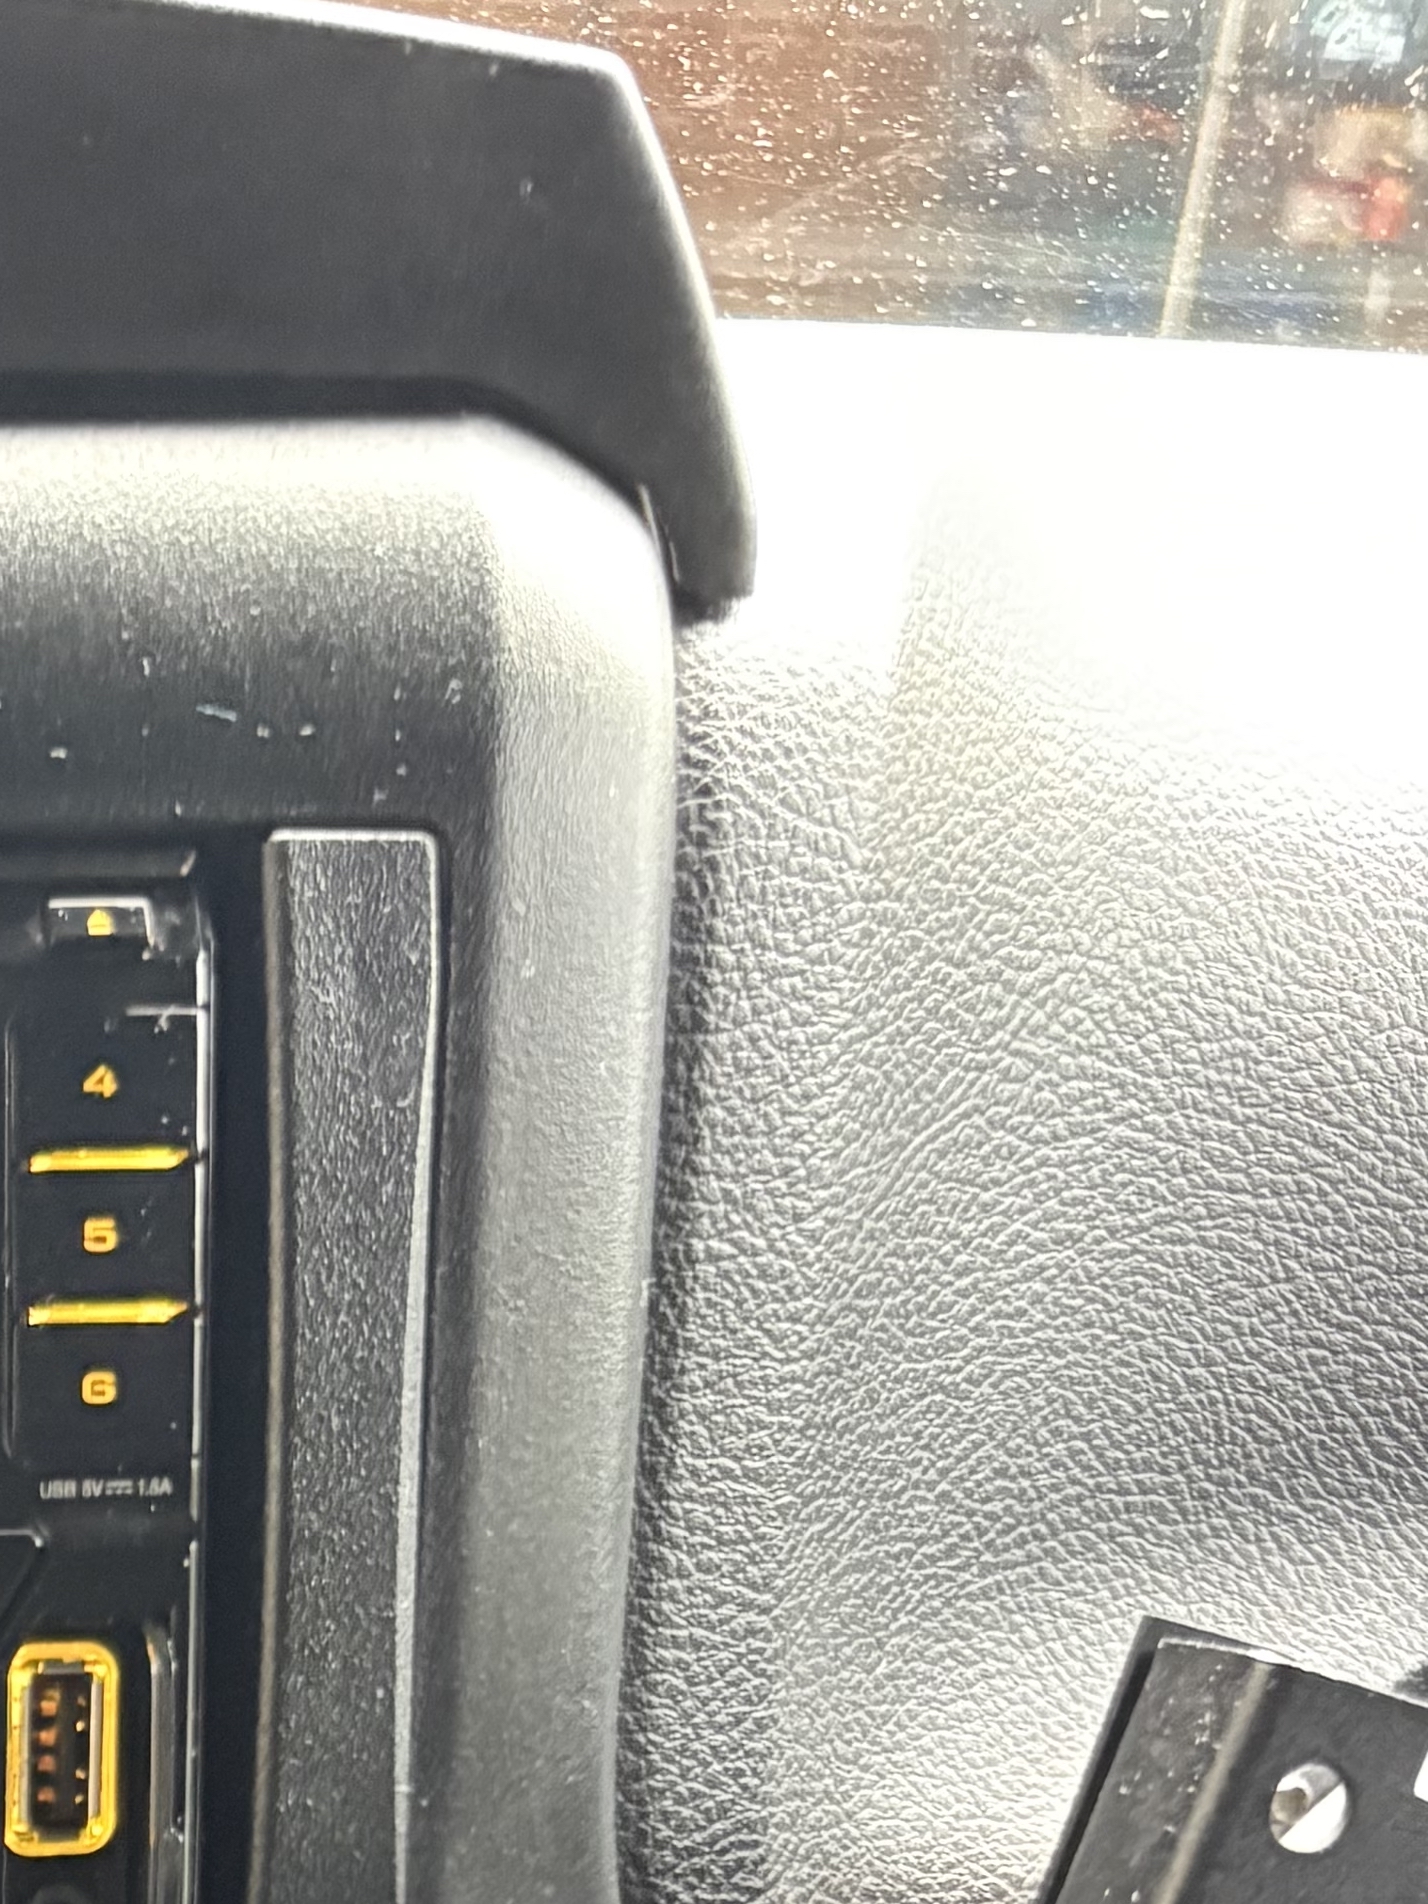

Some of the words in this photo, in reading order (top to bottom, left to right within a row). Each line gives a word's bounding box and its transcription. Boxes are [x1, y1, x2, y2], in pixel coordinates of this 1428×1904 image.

[83, 1065, 117, 1097] 4
[83, 1219, 117, 1252] 5
[81, 1372, 116, 1405] 6
